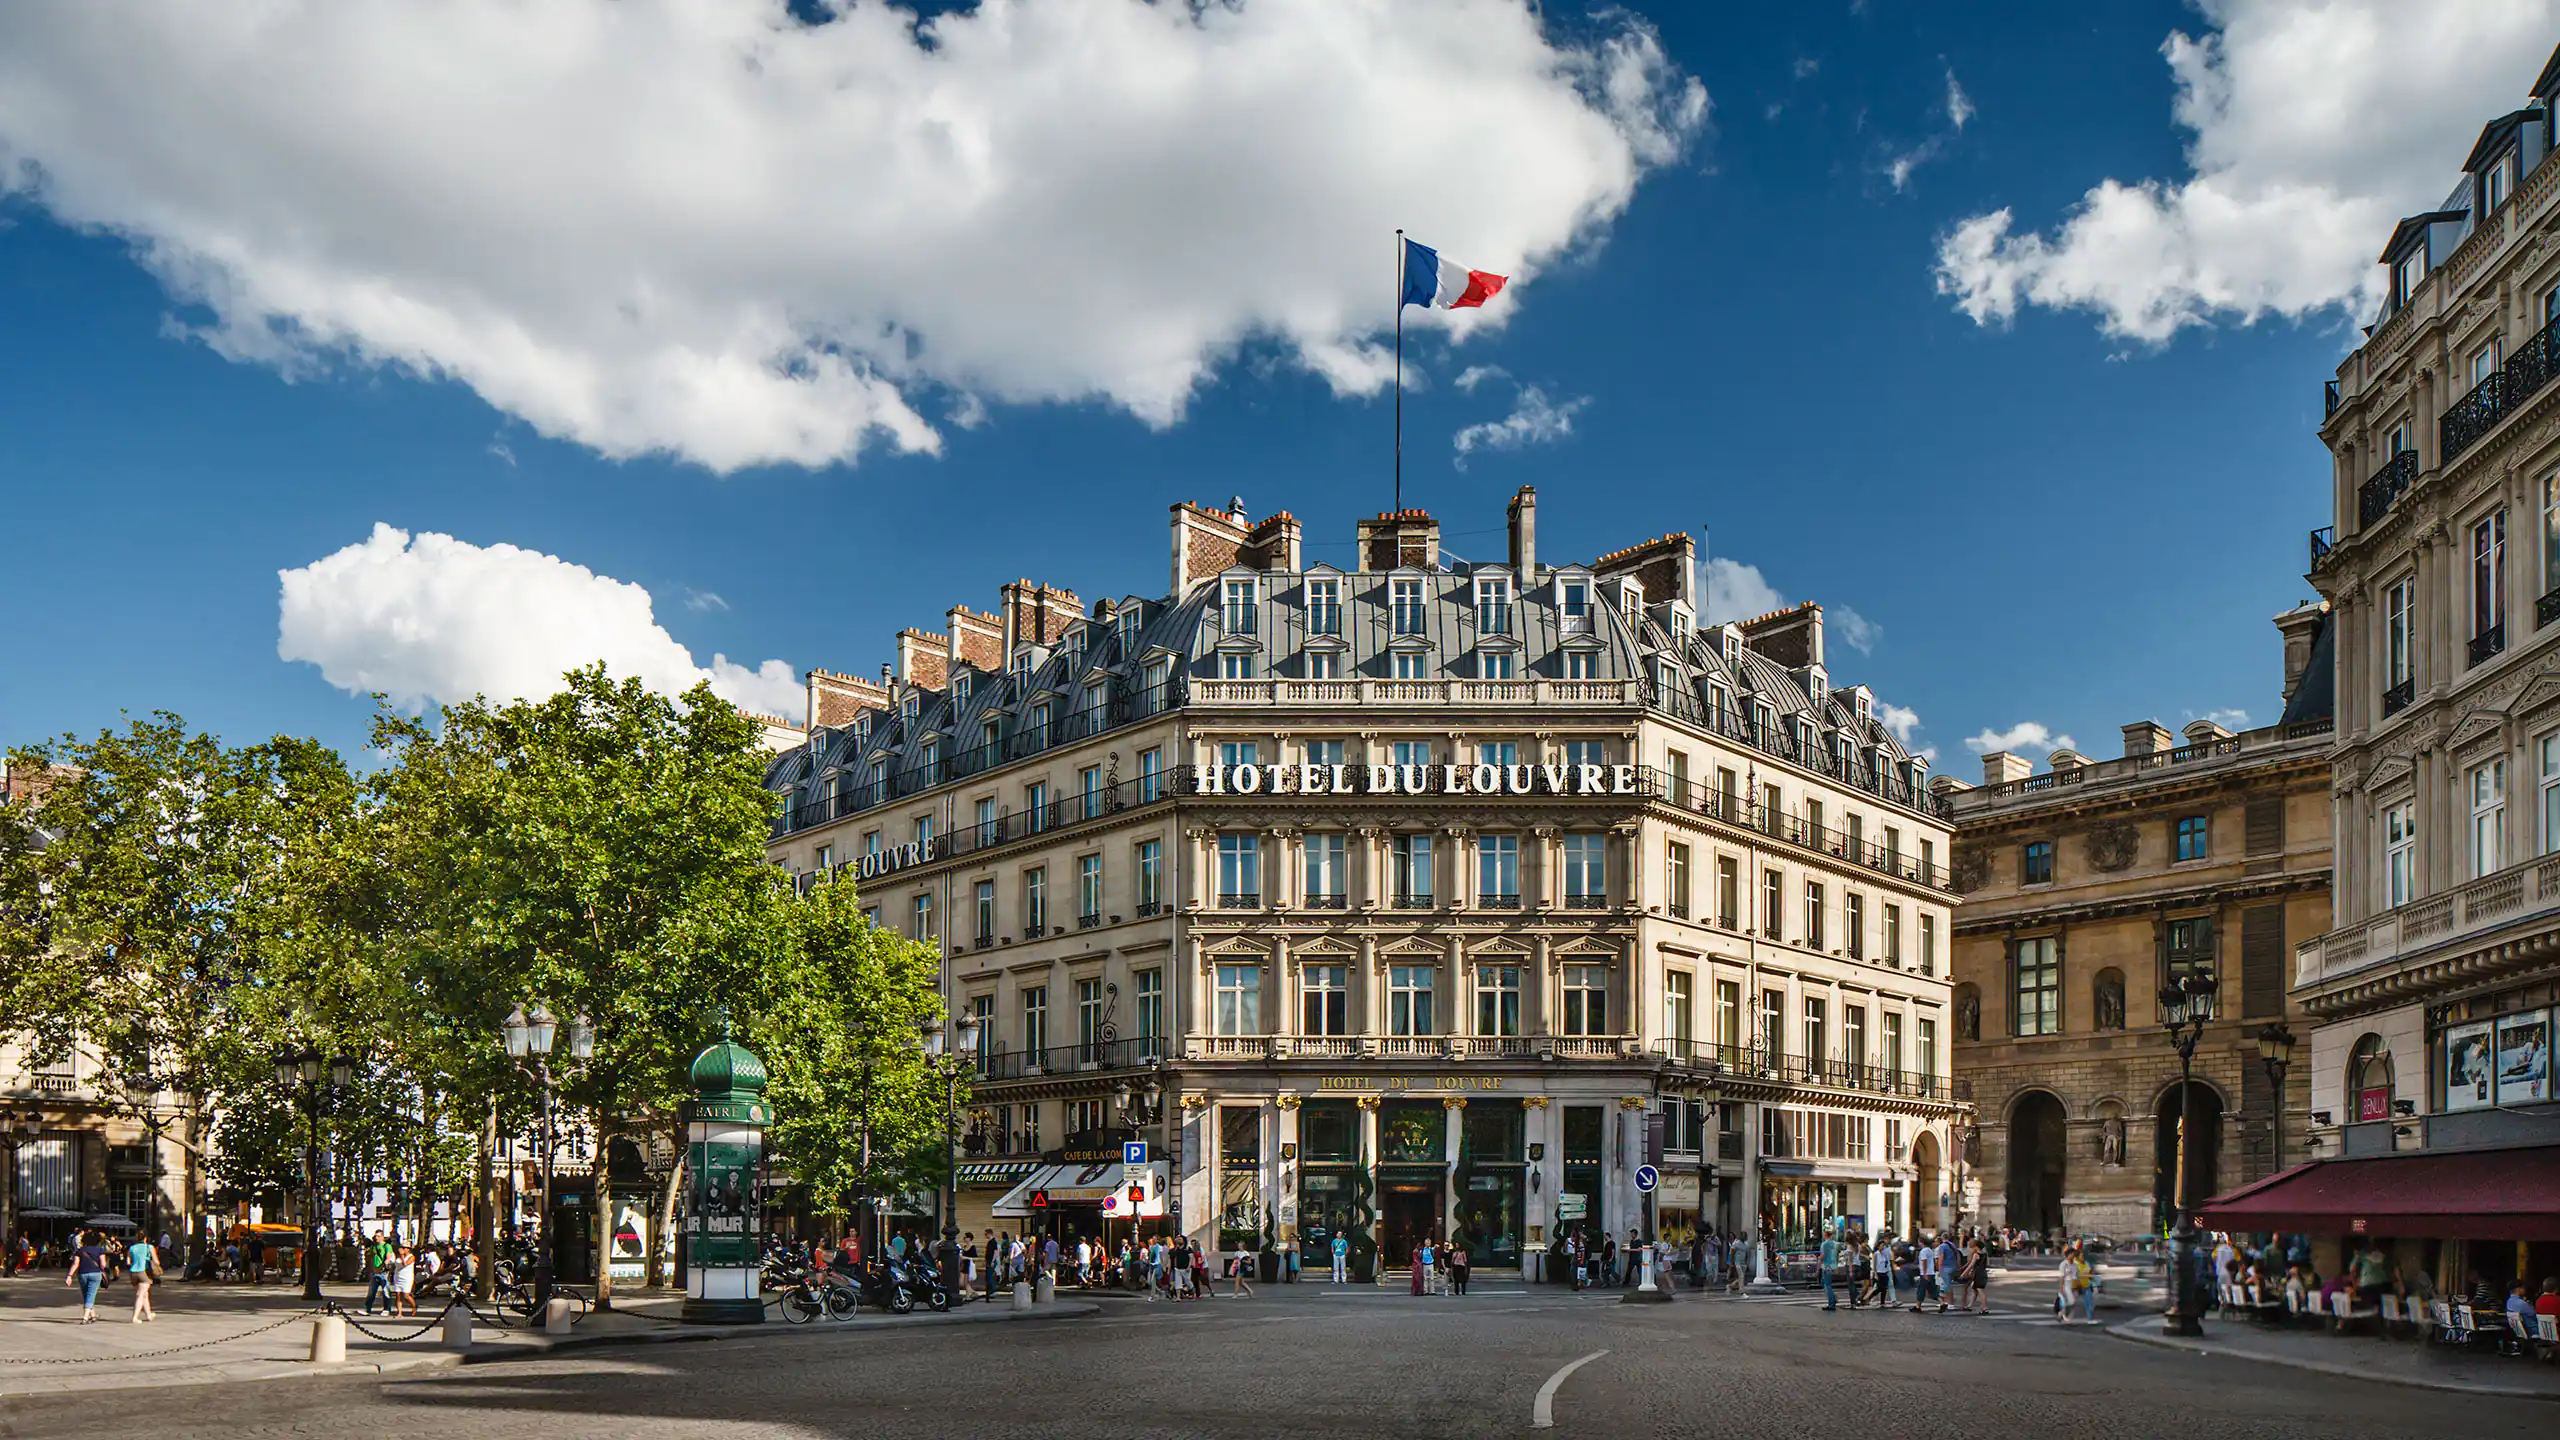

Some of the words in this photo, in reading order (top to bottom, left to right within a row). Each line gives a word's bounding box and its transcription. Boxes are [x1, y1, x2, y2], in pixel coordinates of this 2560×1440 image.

[1194, 764, 1353, 794] HOTEL
[1367, 764, 1428, 794] DU
[1444, 764, 1637, 794] LOUVRE
[1321, 1076, 1375, 1089] HOTEL
[1389, 1076, 1415, 1089] DU
[1435, 1076, 1503, 1089] LOUVRE
[1064, 1151, 1081, 1161] CAFE
[1082, 1150, 1093, 1160] DE
[1094, 1149, 1105, 1160] LA
[1130, 1146, 1141, 1161] P
[708, 1216, 743, 1232] MUR
